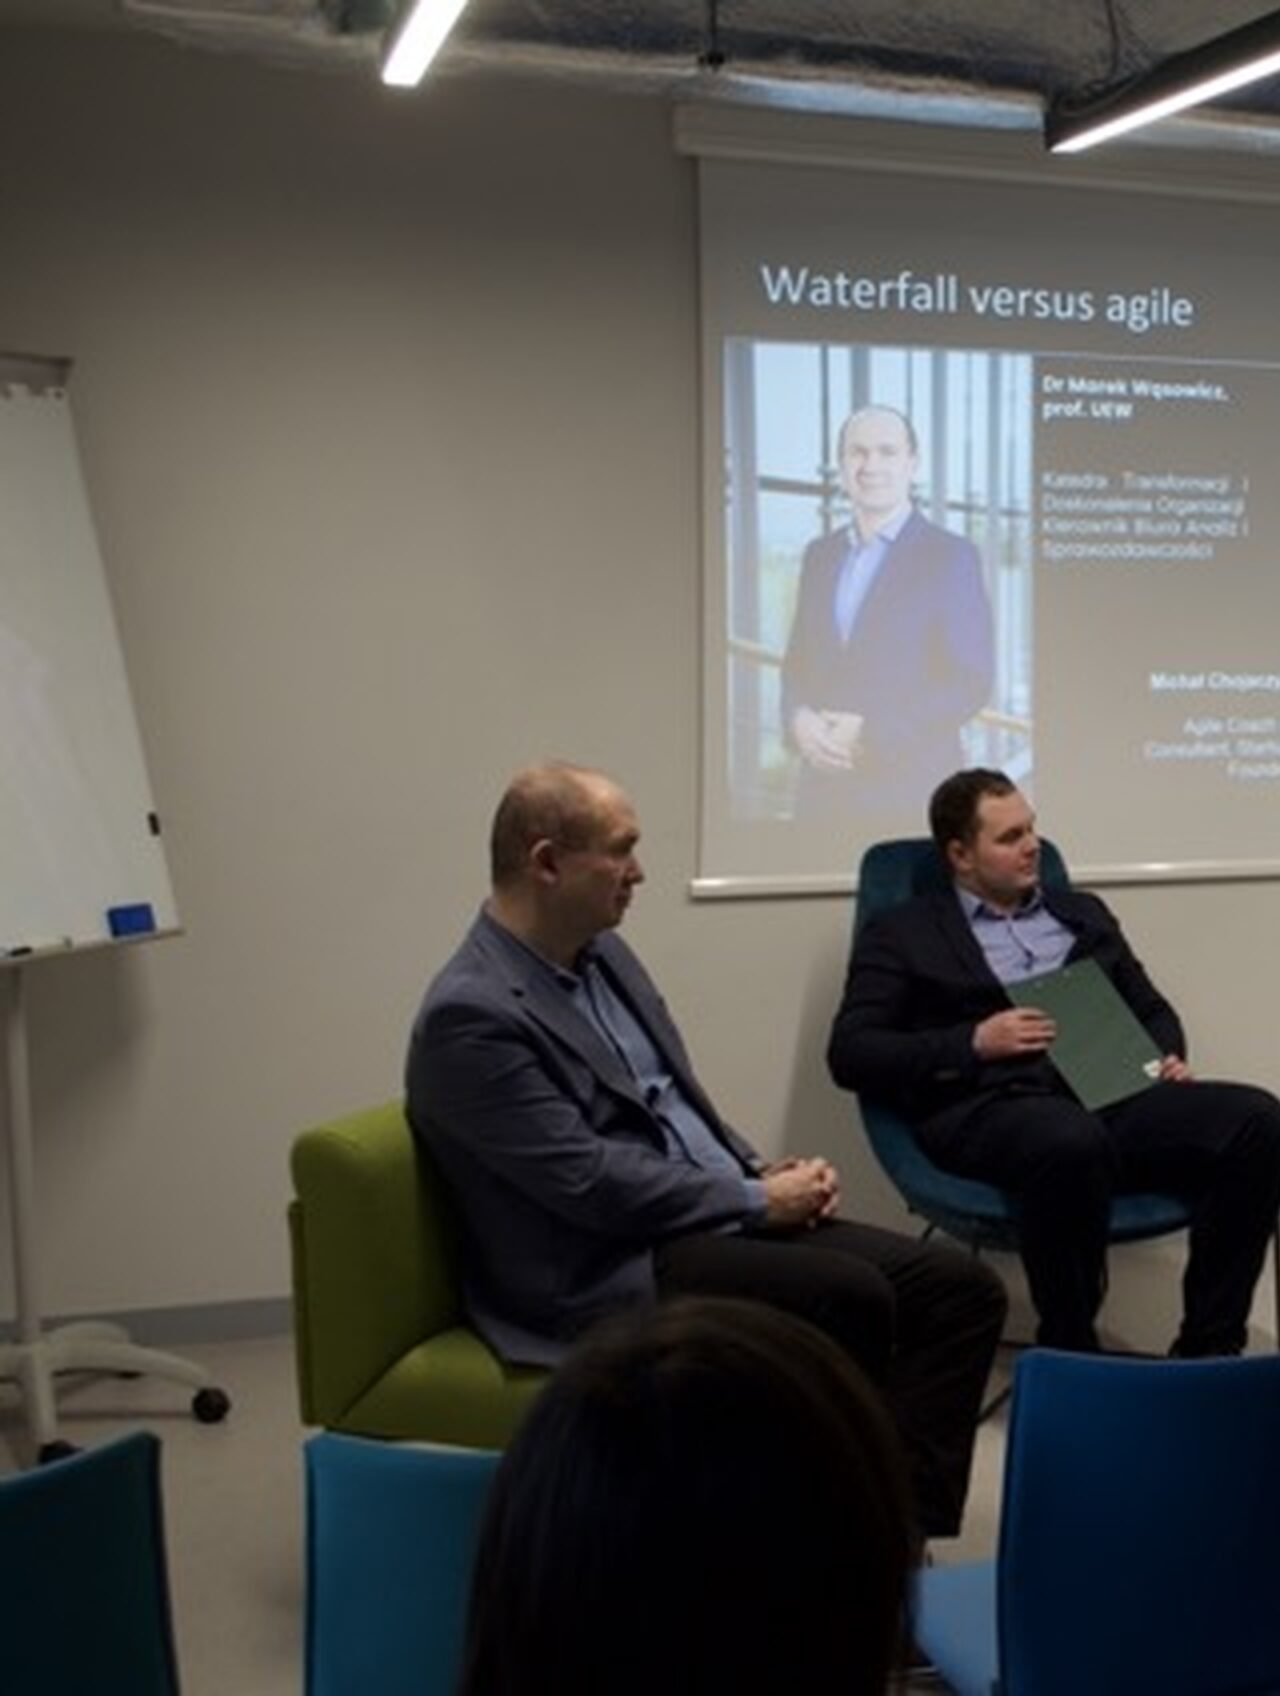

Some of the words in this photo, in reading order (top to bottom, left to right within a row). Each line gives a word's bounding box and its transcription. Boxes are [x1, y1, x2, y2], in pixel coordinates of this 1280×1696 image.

[761, 265, 958, 313] Waterfall
[969, 286, 1095, 323] versus
[1106, 288, 1194, 333] agile
[1042, 375, 1065, 392] Dr
[1067, 377, 1127, 396] Marek
[1042, 400, 1087, 421] prof.
